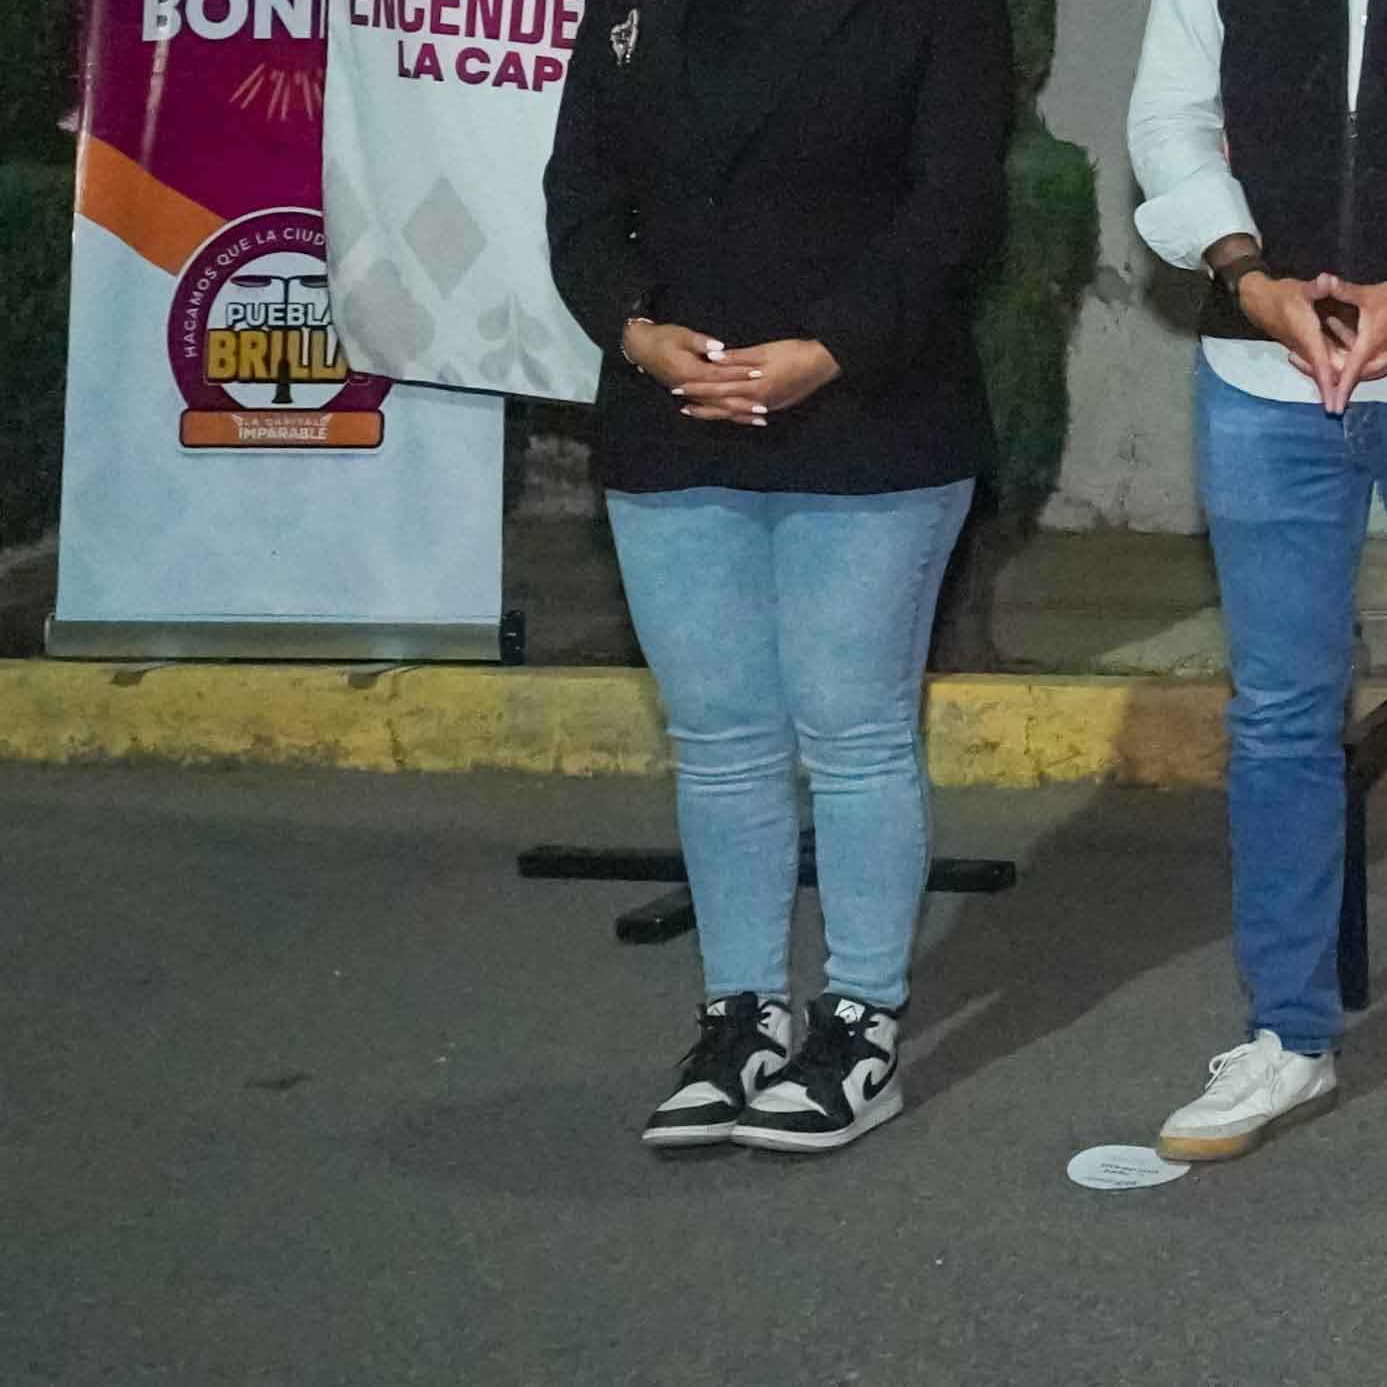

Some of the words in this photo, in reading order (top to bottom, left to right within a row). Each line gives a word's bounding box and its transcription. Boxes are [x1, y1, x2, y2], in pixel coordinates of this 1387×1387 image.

[397, 40, 444, 82] LA
[184, 268, 218, 359] HAGAMOS
[216, 238, 252, 266] QUE
[255, 229, 276, 245] LA
[238, 427, 328, 440] IMPARABLE
